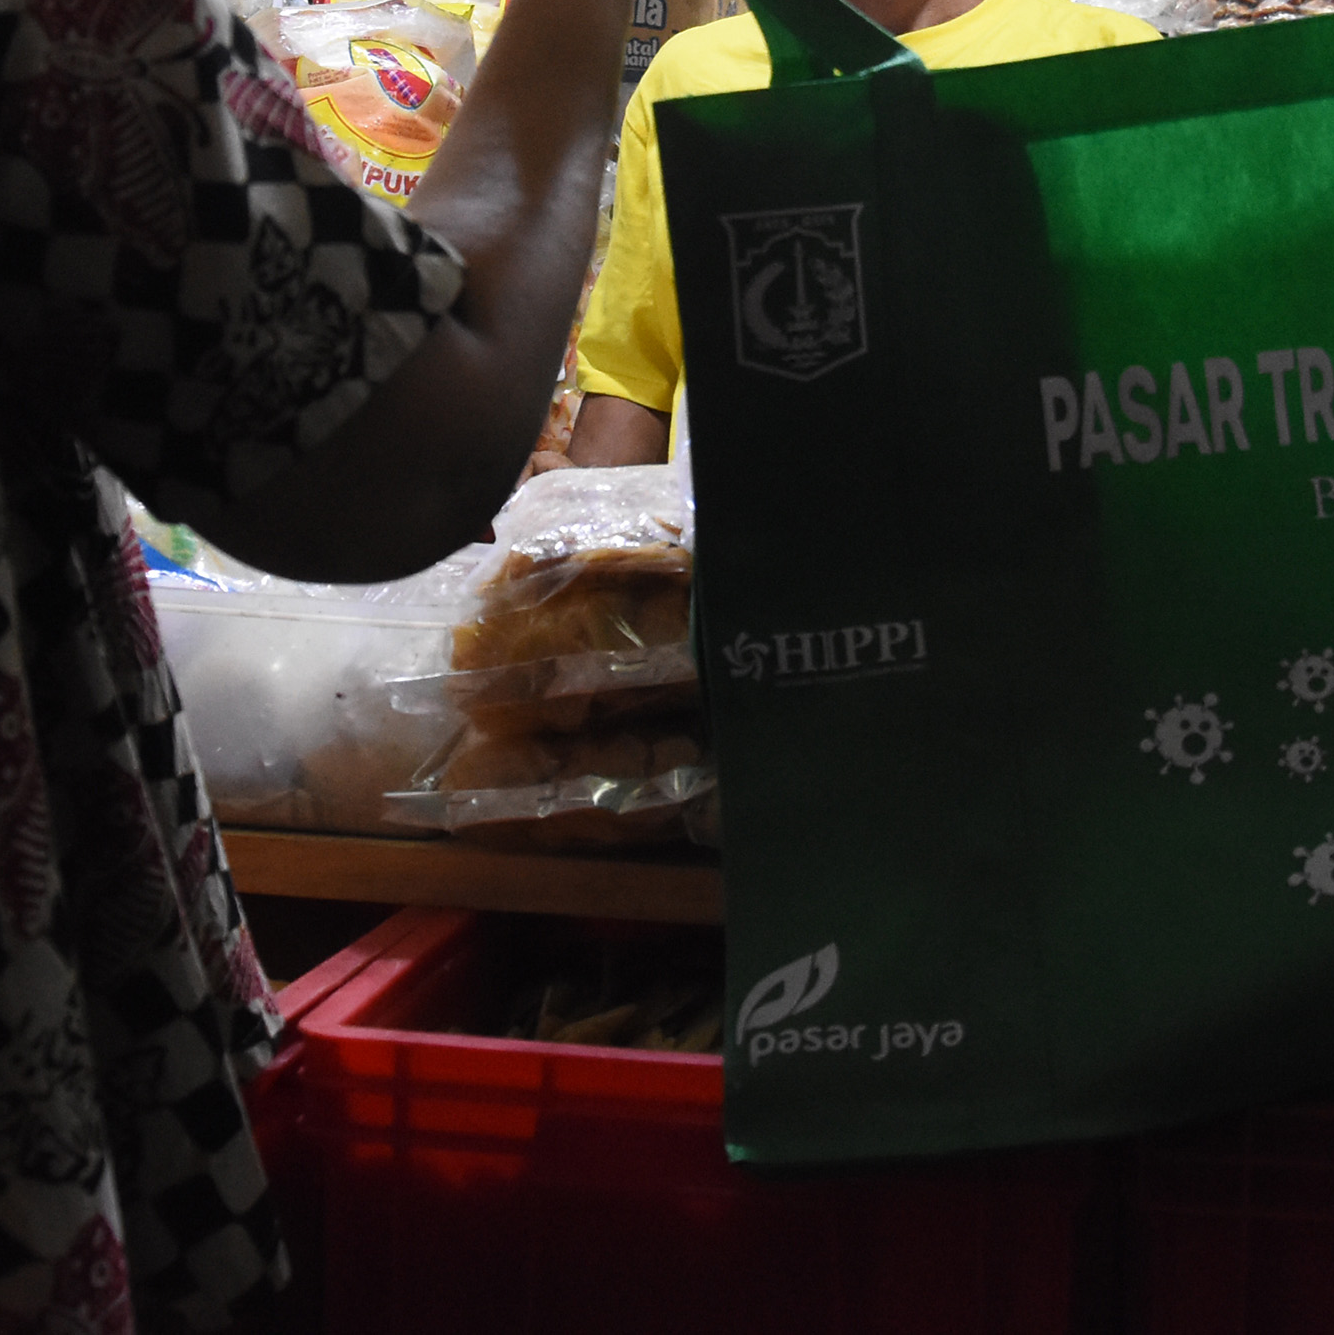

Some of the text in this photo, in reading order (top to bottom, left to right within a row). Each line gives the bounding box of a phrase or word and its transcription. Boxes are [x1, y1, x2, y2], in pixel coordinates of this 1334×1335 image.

[1039, 356, 1251, 473] PASAR
[771, 618, 928, 676] HIPPI
[749, 1019, 965, 1069] pasar jaya
